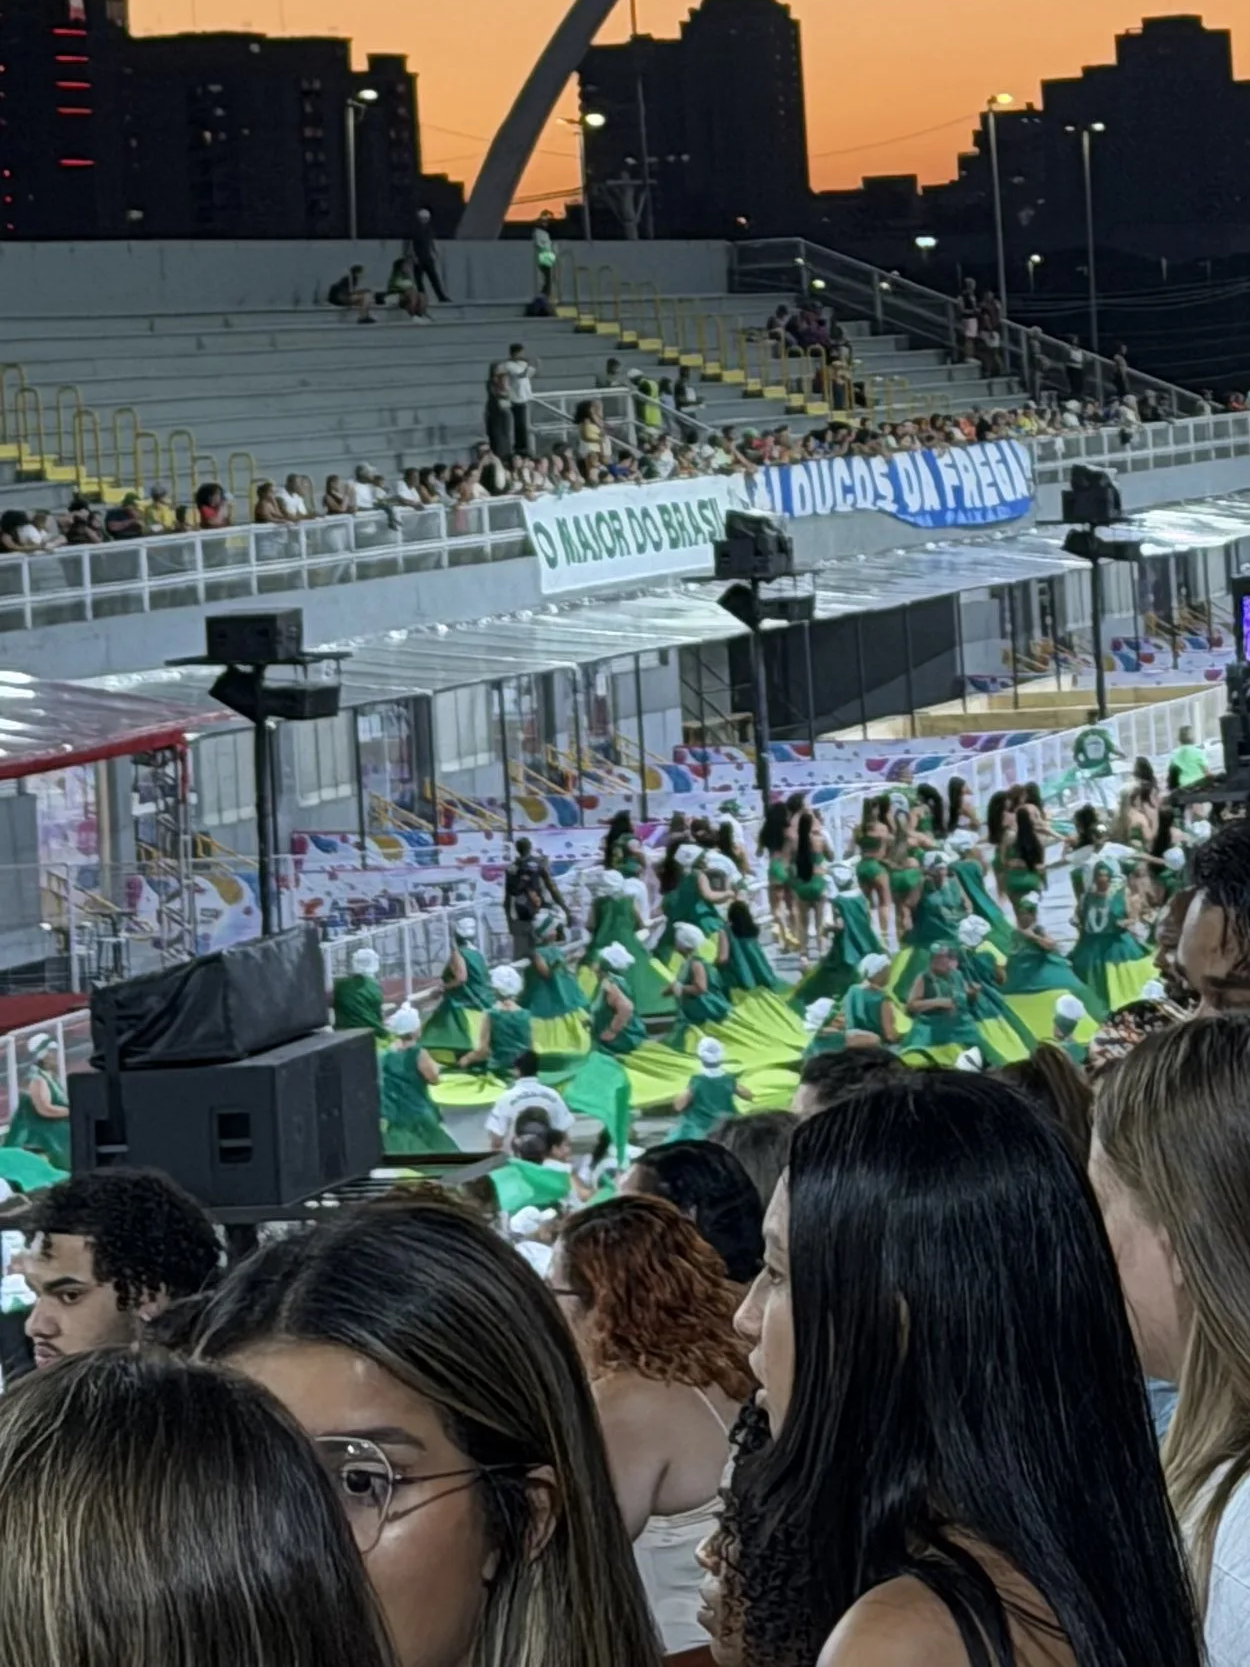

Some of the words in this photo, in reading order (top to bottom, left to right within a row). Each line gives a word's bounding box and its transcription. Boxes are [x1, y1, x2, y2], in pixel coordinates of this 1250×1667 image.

[893, 450, 941, 514] DA
[532, 520, 558, 569] O
[555, 509, 631, 566] MAIOR
[624, 505, 664, 554] DO
